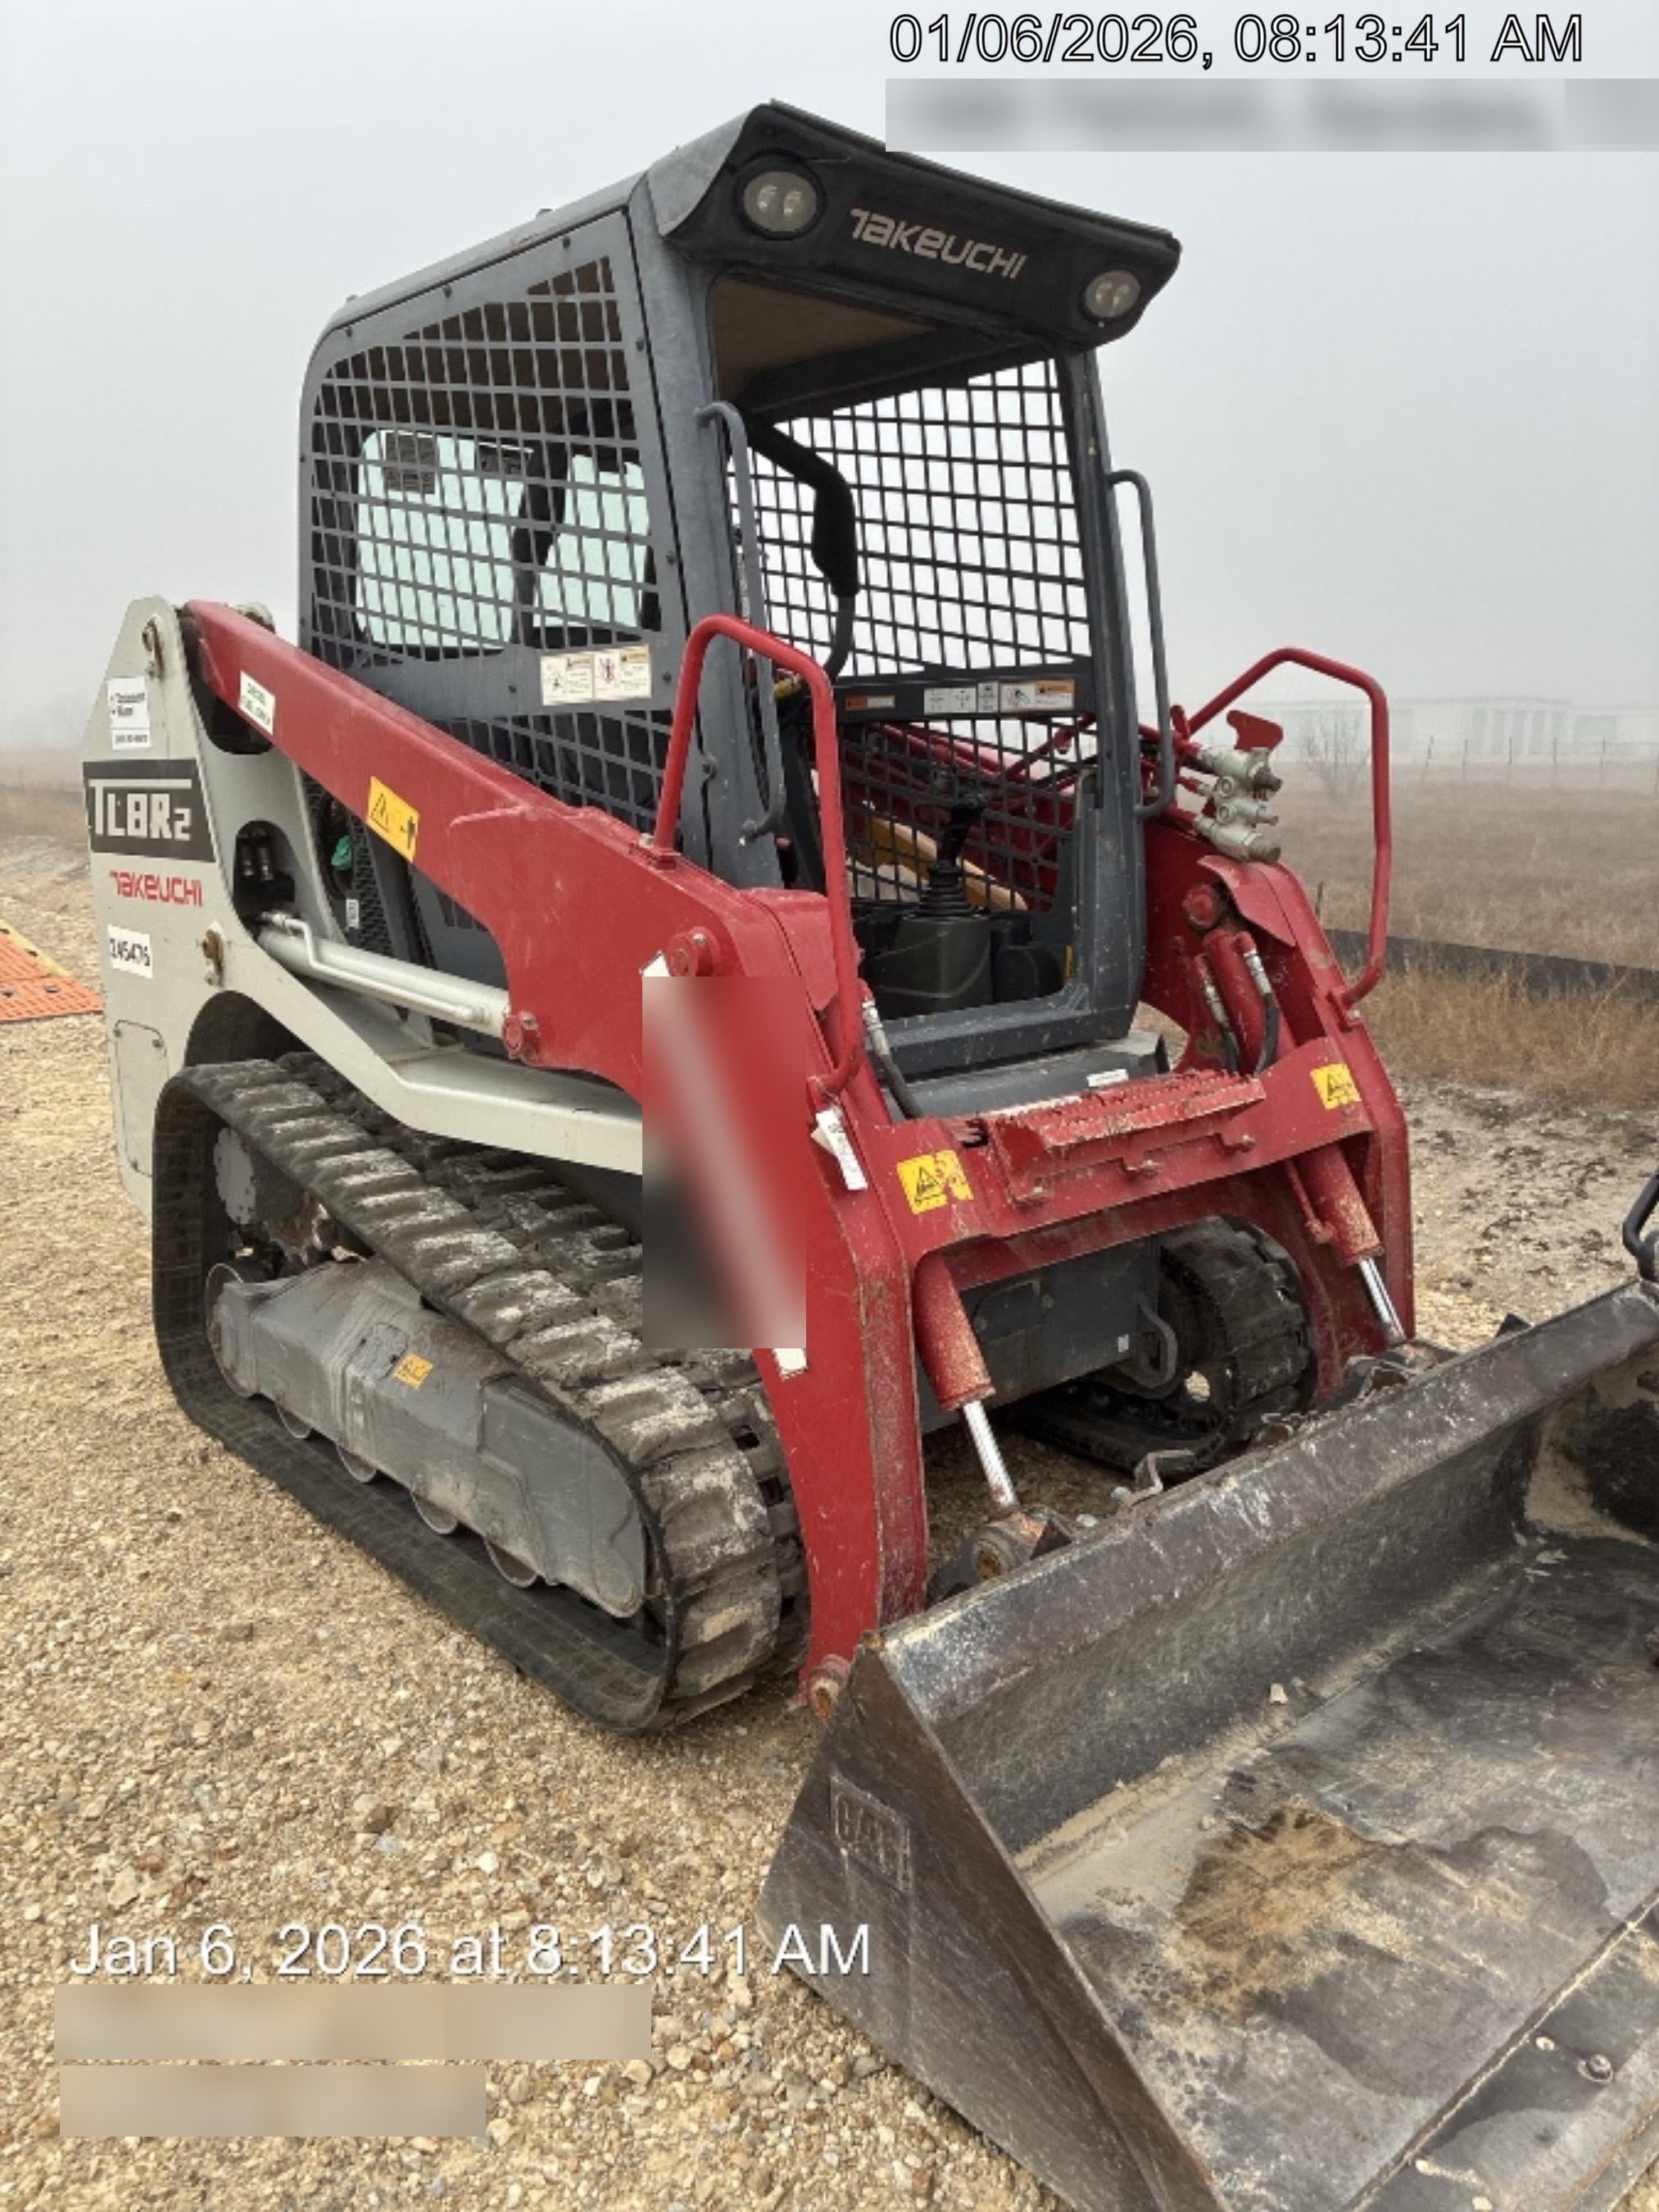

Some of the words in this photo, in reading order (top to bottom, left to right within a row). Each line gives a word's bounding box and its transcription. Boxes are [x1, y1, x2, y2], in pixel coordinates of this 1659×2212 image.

[850, 208, 1027, 279] TAKEUCHI
[88, 778, 193, 841] TL8R2
[110, 869, 202, 907] TAKEUCHI
